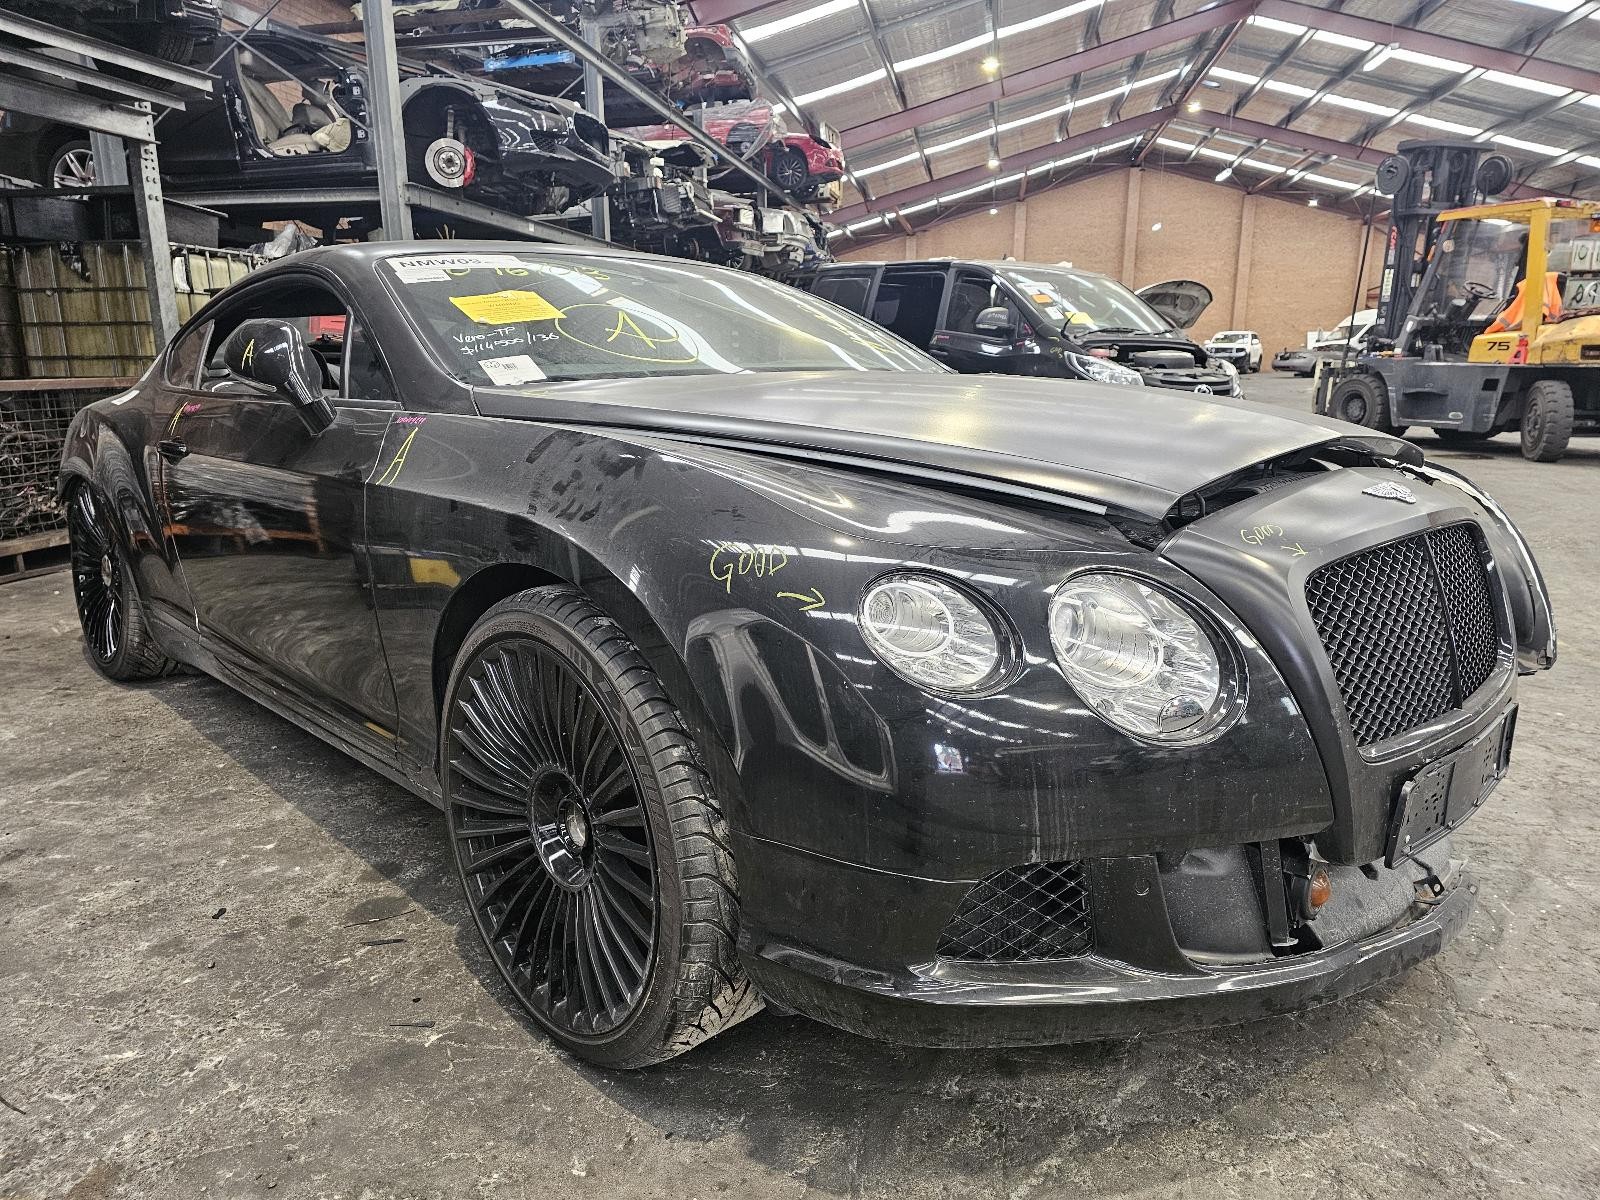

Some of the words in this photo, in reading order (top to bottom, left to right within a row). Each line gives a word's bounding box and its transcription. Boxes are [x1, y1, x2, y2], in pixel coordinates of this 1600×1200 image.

[241, 338, 255, 370] A
[1487, 341, 1510, 351] 75
[375, 426, 419, 486] A
[709, 543, 788, 594] GOOD
